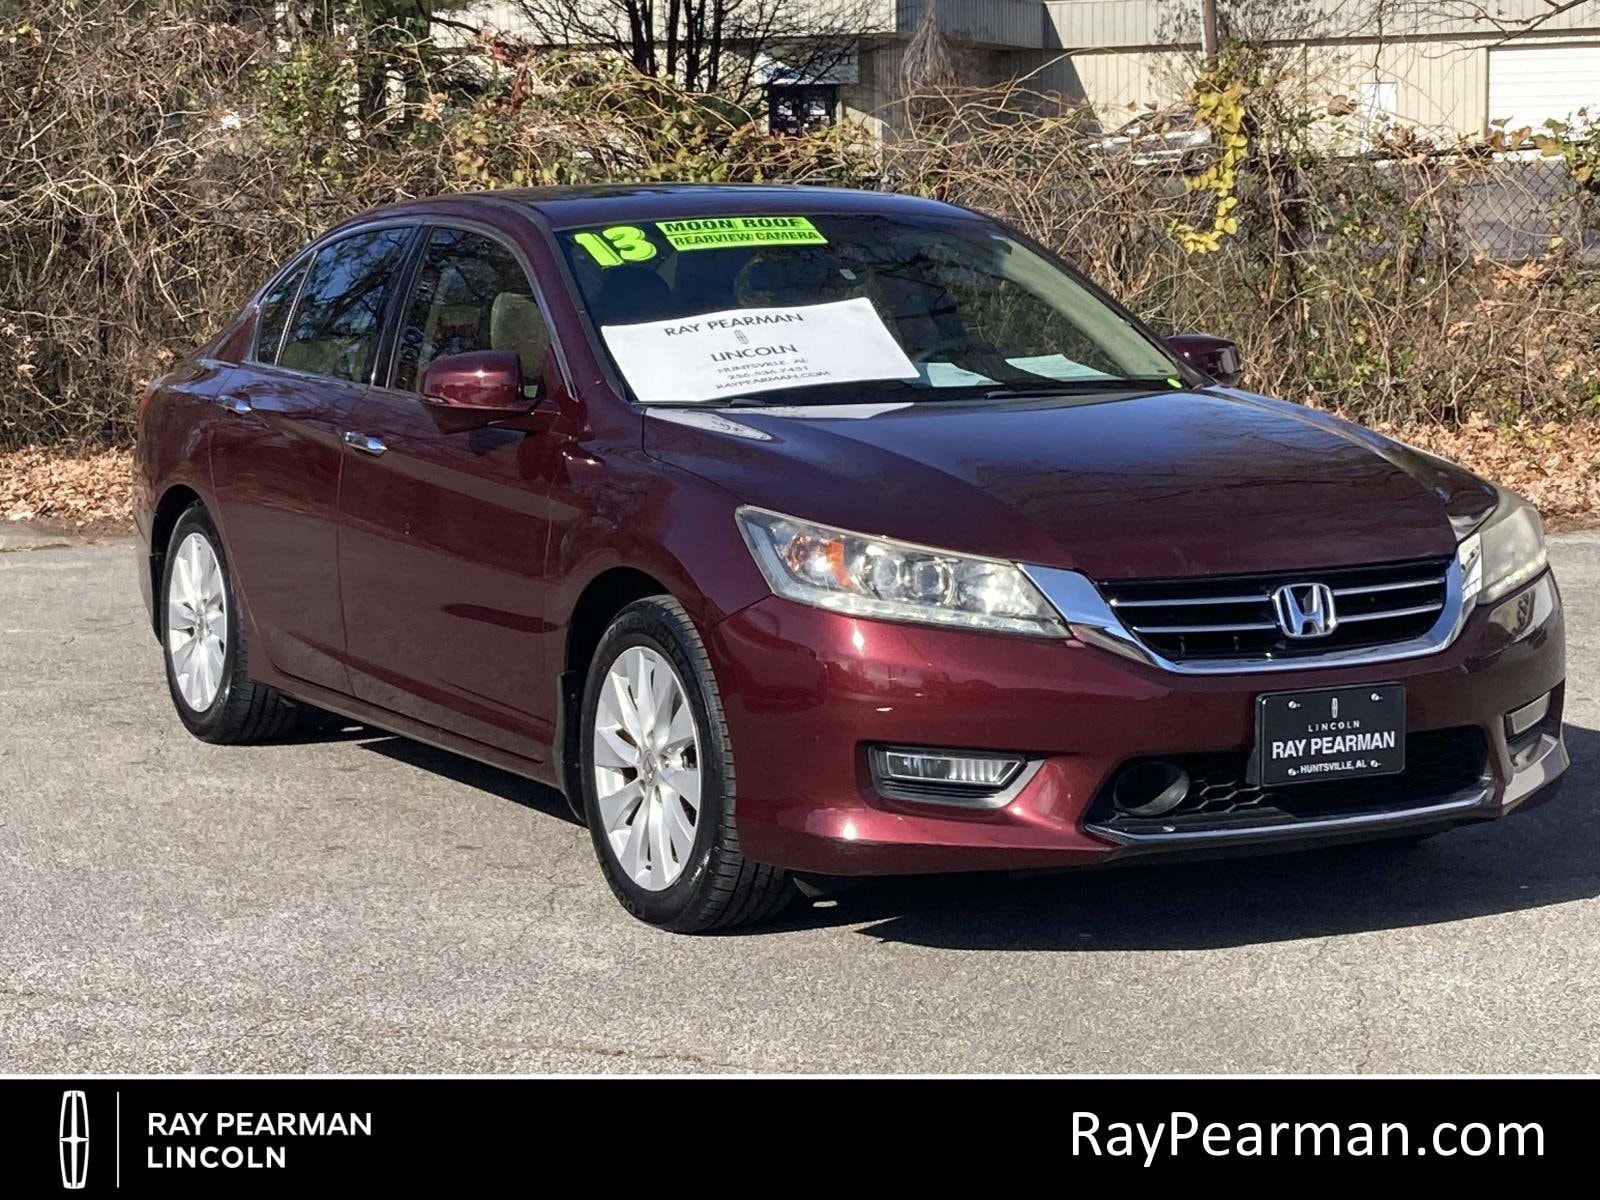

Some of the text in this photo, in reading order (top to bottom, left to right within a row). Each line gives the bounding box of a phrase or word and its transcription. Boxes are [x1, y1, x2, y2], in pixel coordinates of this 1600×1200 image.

[666, 218, 801, 233] MOON ROOF
[574, 225, 657, 267] 13
[674, 230, 820, 246] REARVIEW CAMERA
[664, 313, 804, 337] RAY PEARMAN
[710, 344, 798, 362] LINCOLN
[1308, 720, 1360, 732] LINCOLN
[1272, 731, 1395, 759] RAY PEARMAN
[1355, 759, 1367, 768] AL
